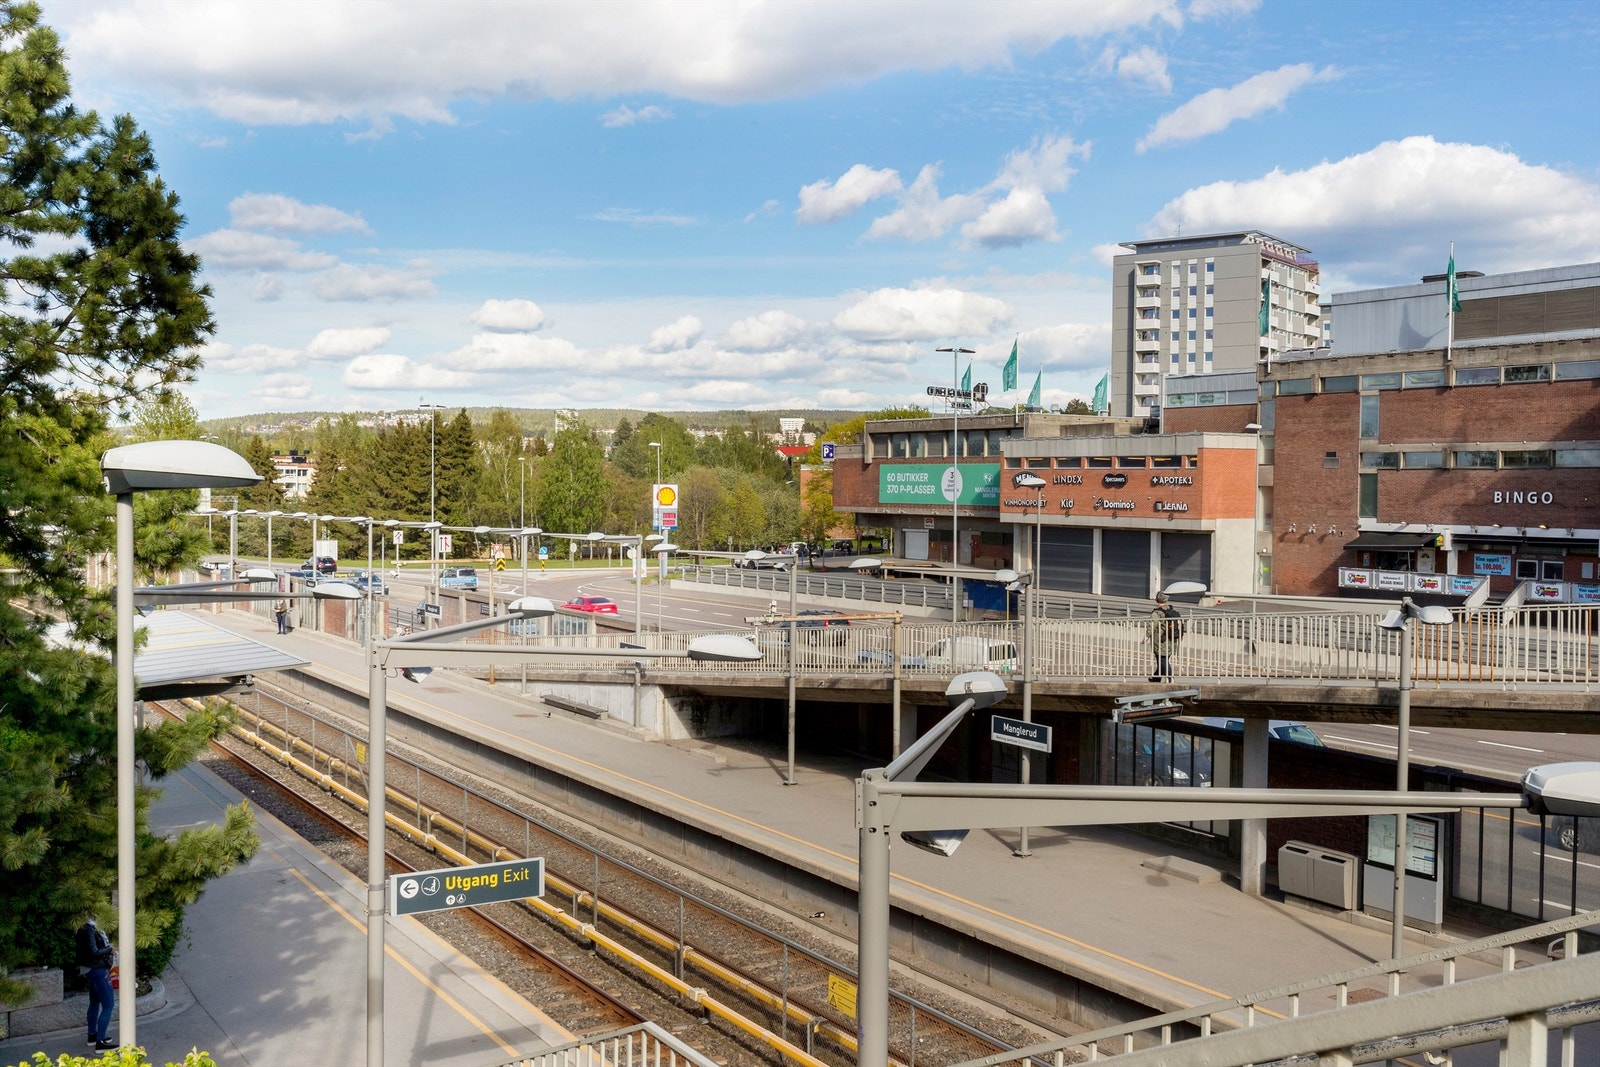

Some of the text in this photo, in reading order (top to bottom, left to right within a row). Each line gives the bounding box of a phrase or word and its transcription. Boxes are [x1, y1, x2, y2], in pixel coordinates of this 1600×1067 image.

[824, 447, 830, 457] P
[887, 472, 929, 482] 60 BUTIKKER
[1053, 475, 1083, 484] LINDEX
[1159, 476, 1187, 485] APOTEK
[887, 485, 898, 494] 370
[899, 485, 936, 495] P-PLASSER
[1493, 491, 1553, 504] BINGO
[1004, 499, 1047, 508] VINMONOPOET
[1061, 499, 1075, 509] Kid
[1103, 500, 1135, 510] Domino's
[1003, 722, 1038, 739] Manglerud
[445, 867, 530, 891] Utgang Exit
